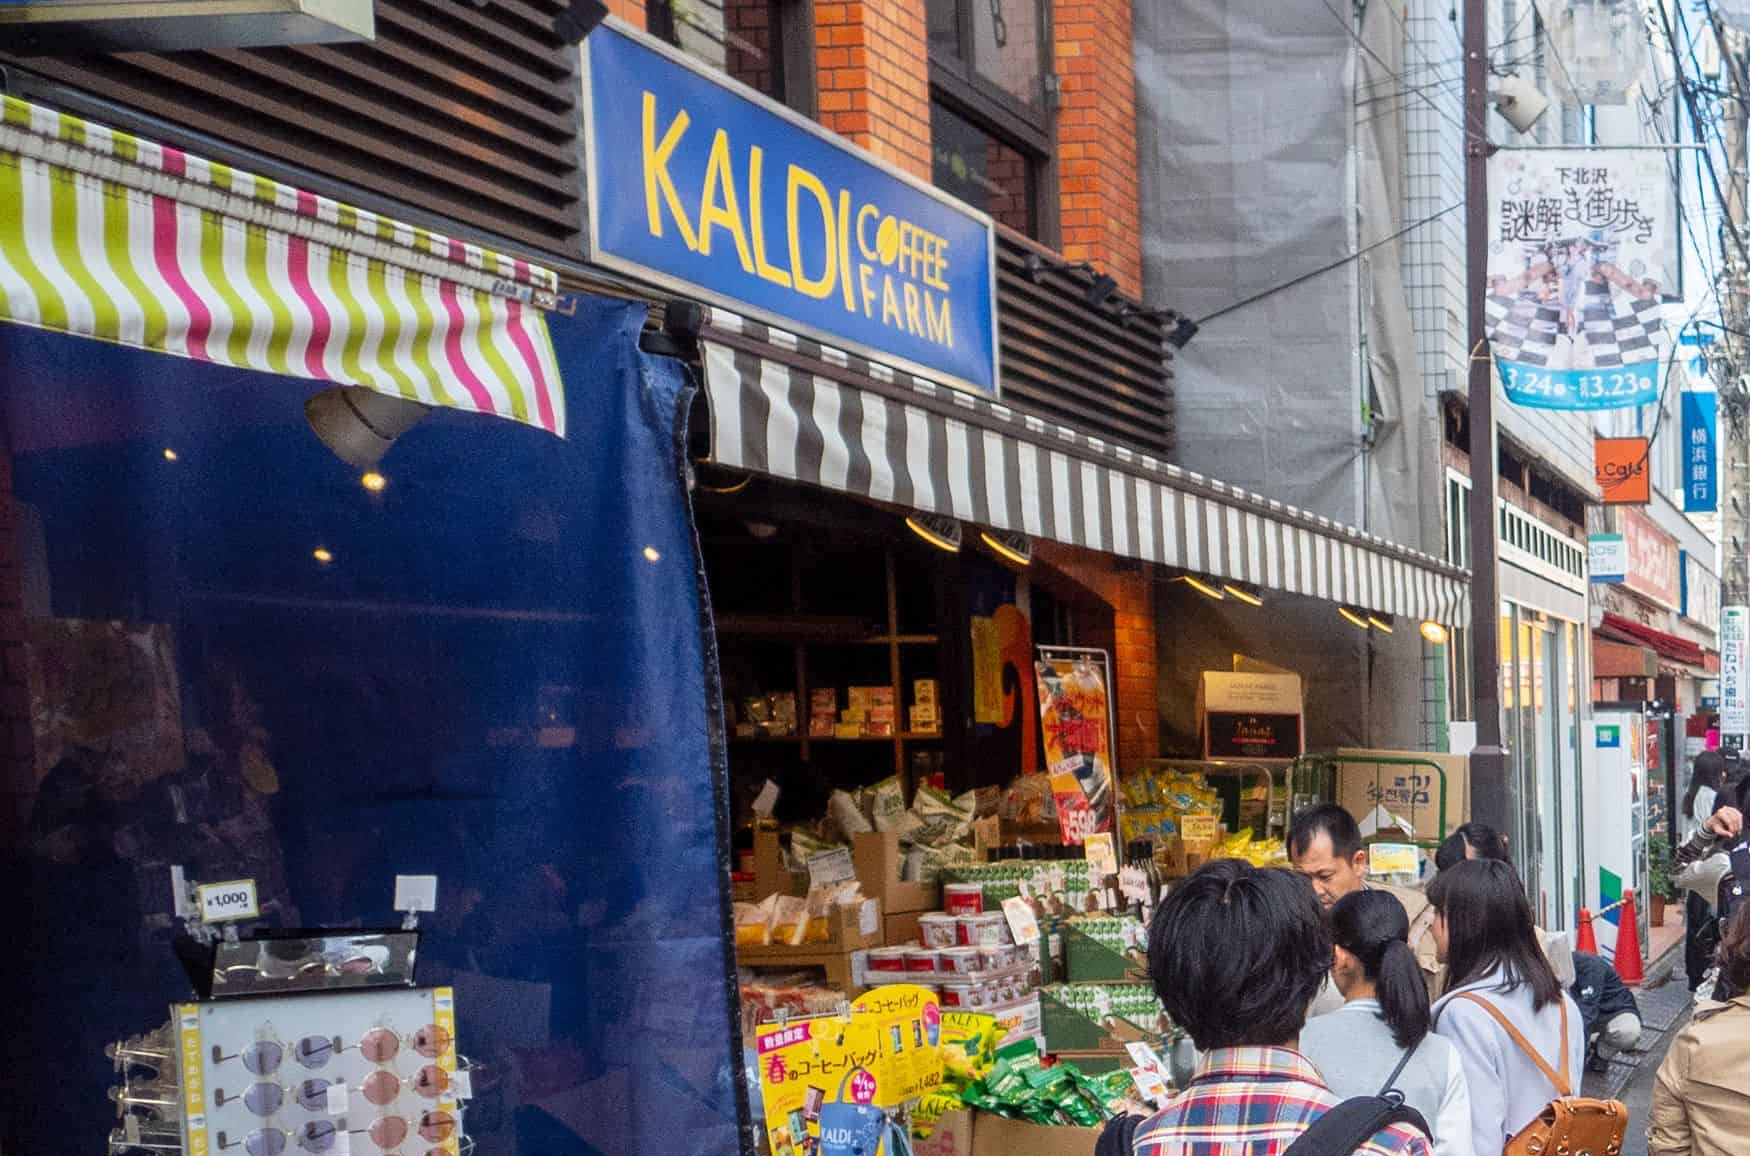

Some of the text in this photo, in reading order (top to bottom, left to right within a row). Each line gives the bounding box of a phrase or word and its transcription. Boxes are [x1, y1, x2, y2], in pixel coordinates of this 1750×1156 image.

[642, 90, 856, 312] KALDI
[1554, 166, 1608, 185] 下北沢
[855, 203, 951, 293] COFFEE
[858, 262, 954, 348] FARM
[1691, 427, 1708, 500] 横浜銀行
[764, 1048, 878, 1086] 春のコーヒーバッグ
[853, 1075, 876, 1093] 4/10
